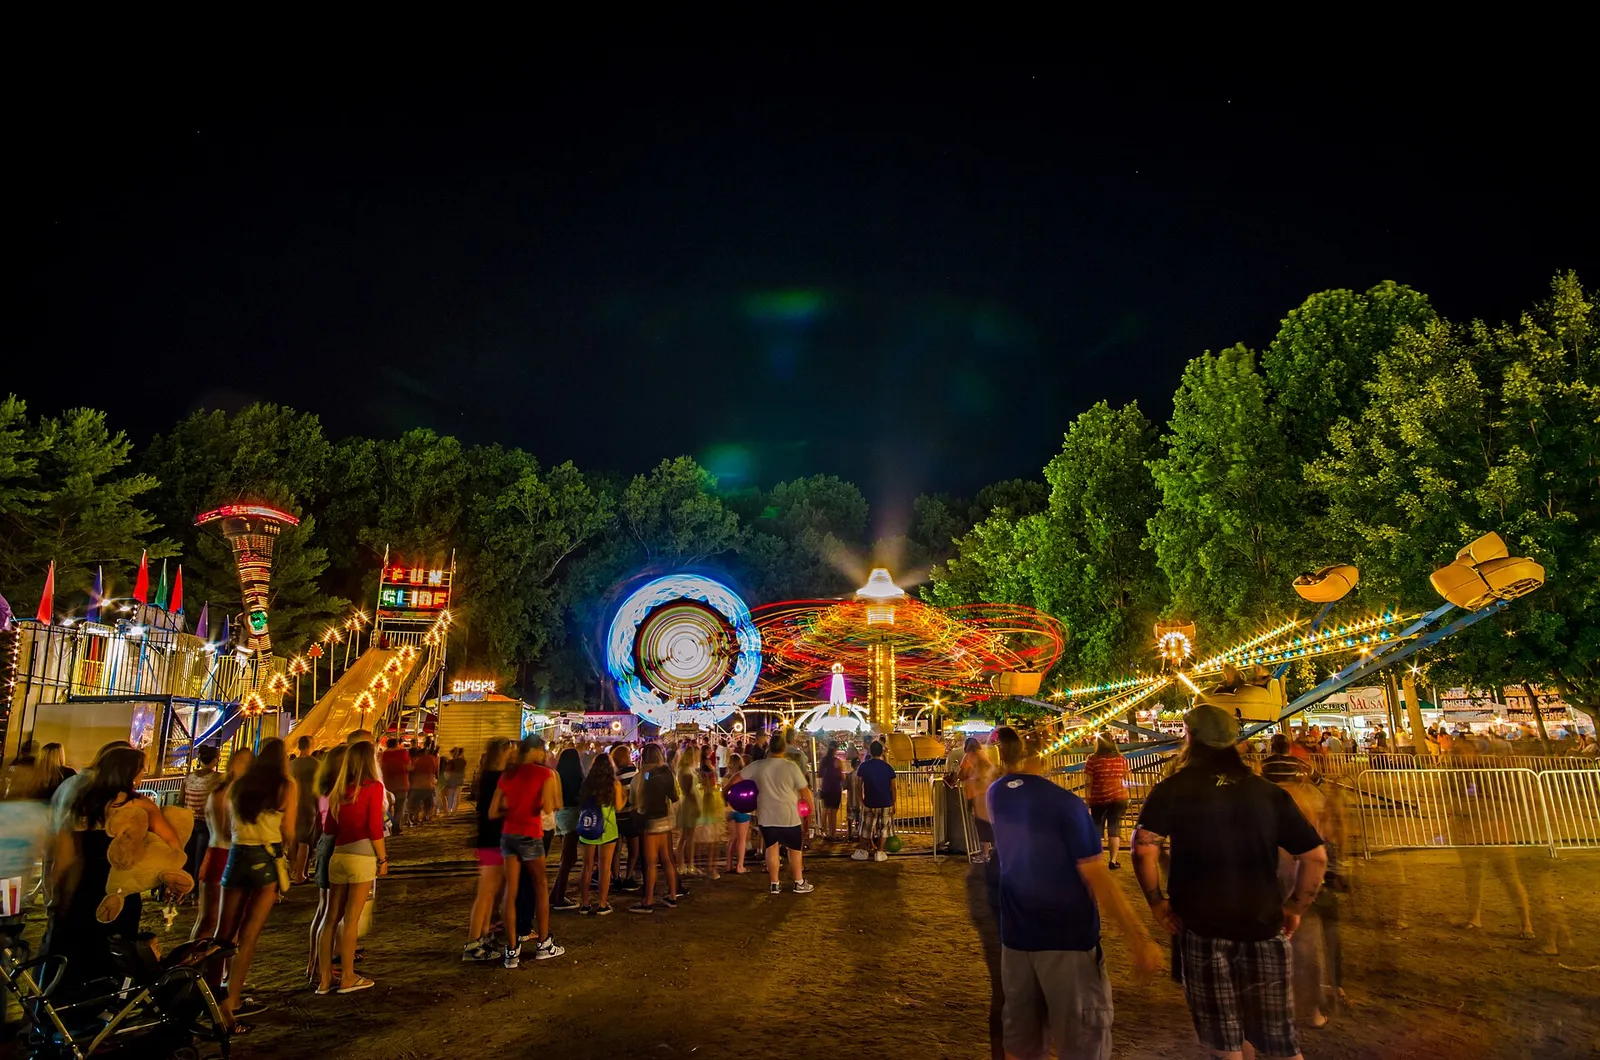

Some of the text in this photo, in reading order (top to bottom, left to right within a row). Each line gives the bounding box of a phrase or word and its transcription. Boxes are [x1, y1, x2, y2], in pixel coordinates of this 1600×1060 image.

[391, 567, 443, 587] FUN
[382, 589, 447, 608] GLIDE
[1349, 694, 1385, 710] SAUSA
[1505, 695, 1549, 710] RIS
